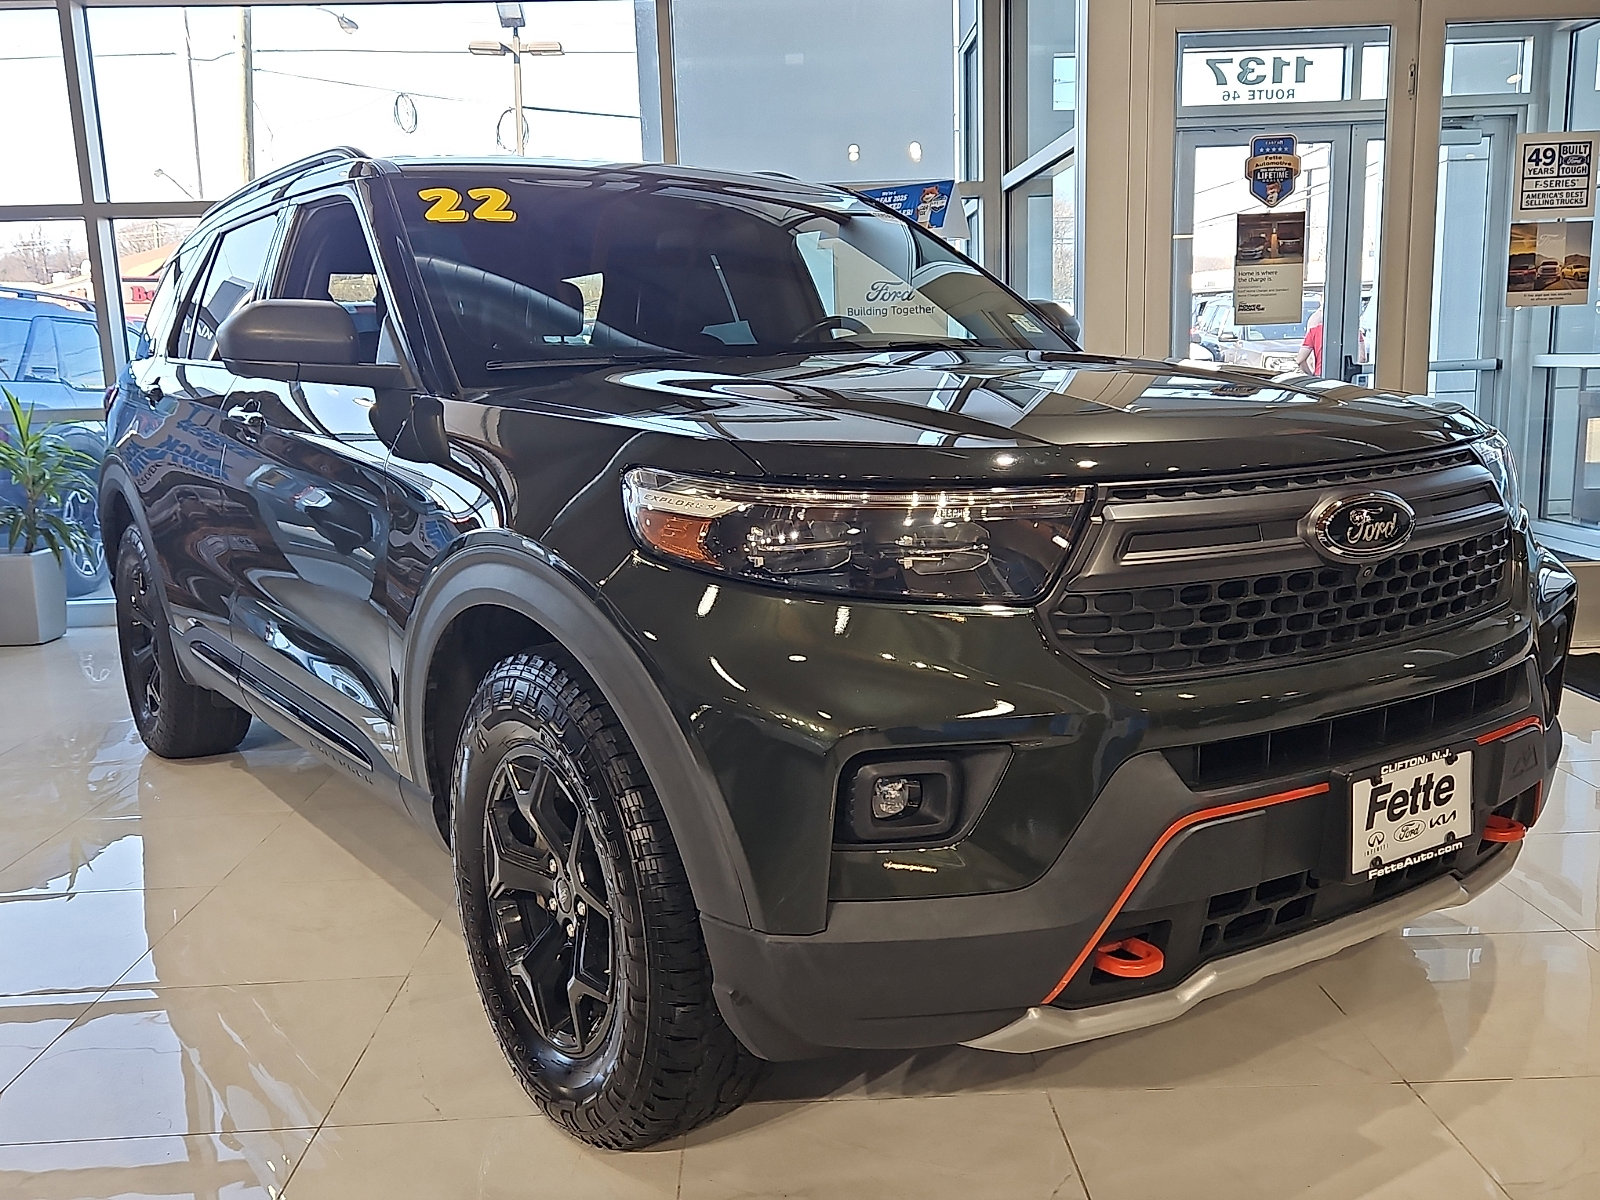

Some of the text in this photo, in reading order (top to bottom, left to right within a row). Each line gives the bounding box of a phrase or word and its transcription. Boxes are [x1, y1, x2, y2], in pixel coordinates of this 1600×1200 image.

[1528, 147, 1556, 166] 49
[1562, 144, 1589, 155] BUILT
[1257, 171, 1289, 179] LIFETIME
[1528, 167, 1555, 175] YEARS
[1561, 166, 1587, 174] TOUGH
[417, 187, 518, 223] 22
[866, 281, 915, 302] Ford
[847, 304, 936, 317] Building Together
[1346, 506, 1399, 544] Ford
[1380, 748, 1452, 775] CLIFTON, N.J.
[1365, 772, 1455, 831] Fette
[1398, 822, 1421, 840] Ford
[1368, 841, 1463, 880] FetteAuto.com
